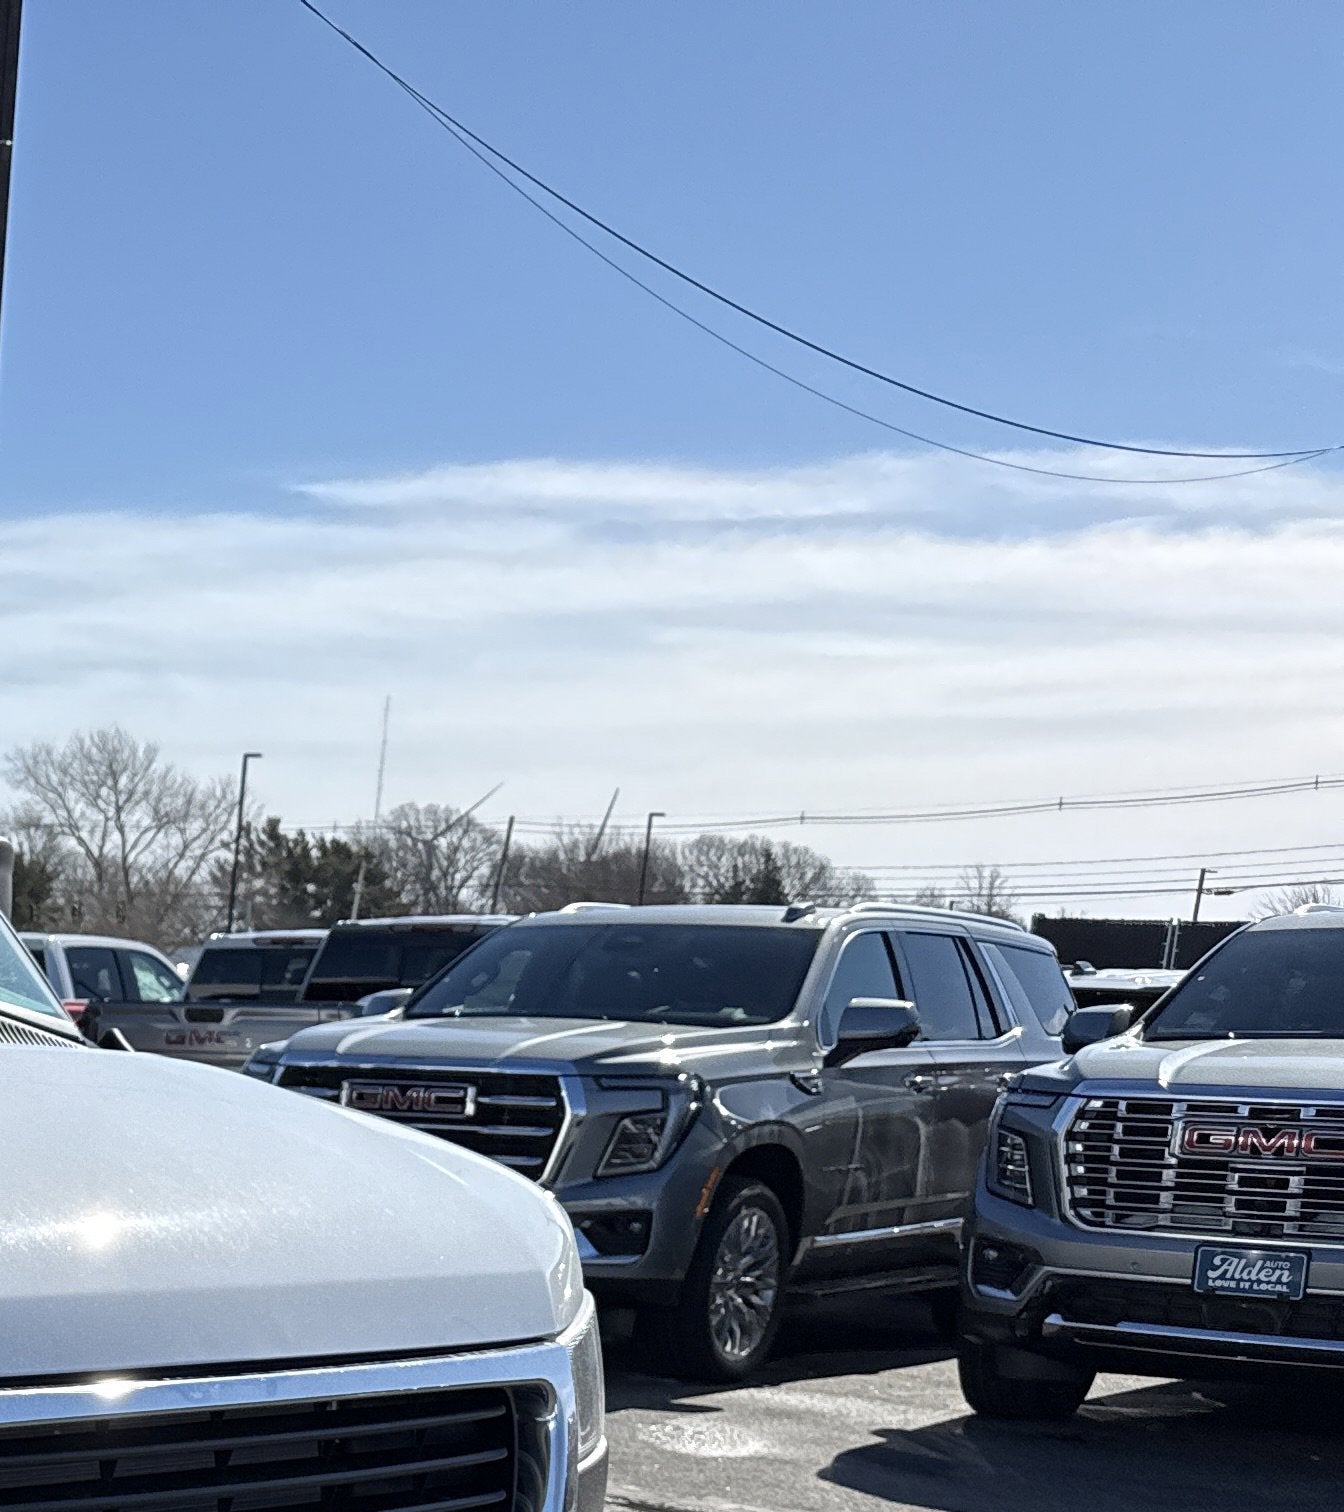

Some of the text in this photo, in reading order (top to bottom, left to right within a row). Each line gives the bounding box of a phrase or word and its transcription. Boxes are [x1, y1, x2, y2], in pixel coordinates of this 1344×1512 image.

[352, 1084, 465, 1112] GMC
[1184, 1125, 1344, 1158] GMC
[1207, 1255, 1293, 1283] Alden
[1264, 1261, 1291, 1269] AUTO
[1208, 1279, 1290, 1292] LOVE IT LOCAL
